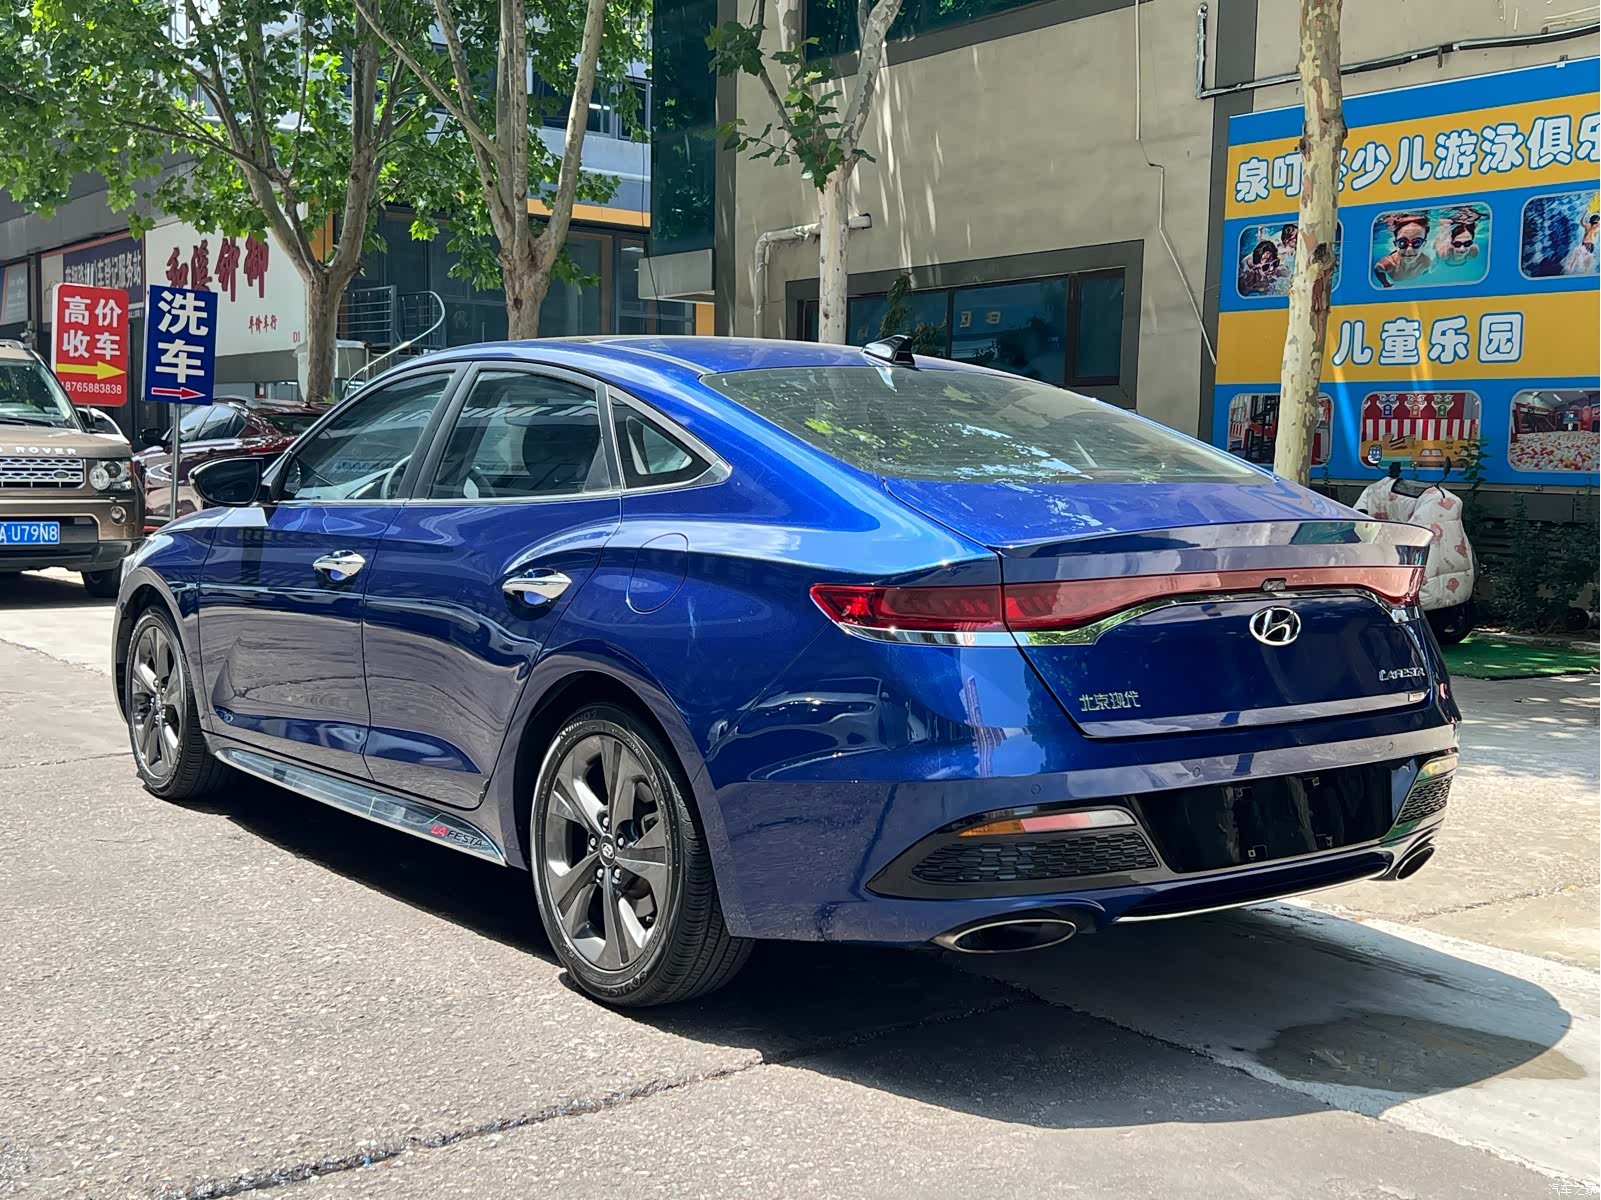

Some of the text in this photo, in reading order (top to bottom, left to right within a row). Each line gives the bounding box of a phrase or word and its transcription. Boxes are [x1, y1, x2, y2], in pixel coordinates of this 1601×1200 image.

[1236, 112, 1600, 202] 泉叮少儿游泳俱乐
[63, 296, 122, 328] 高价
[62, 329, 121, 360] 收车
[1331, 311, 1523, 366] 儿童乐园
[15, 446, 77, 456] ROVER
[1379, 667, 1426, 682] LAFESTA
[1079, 690, 1141, 712] 北京现代
